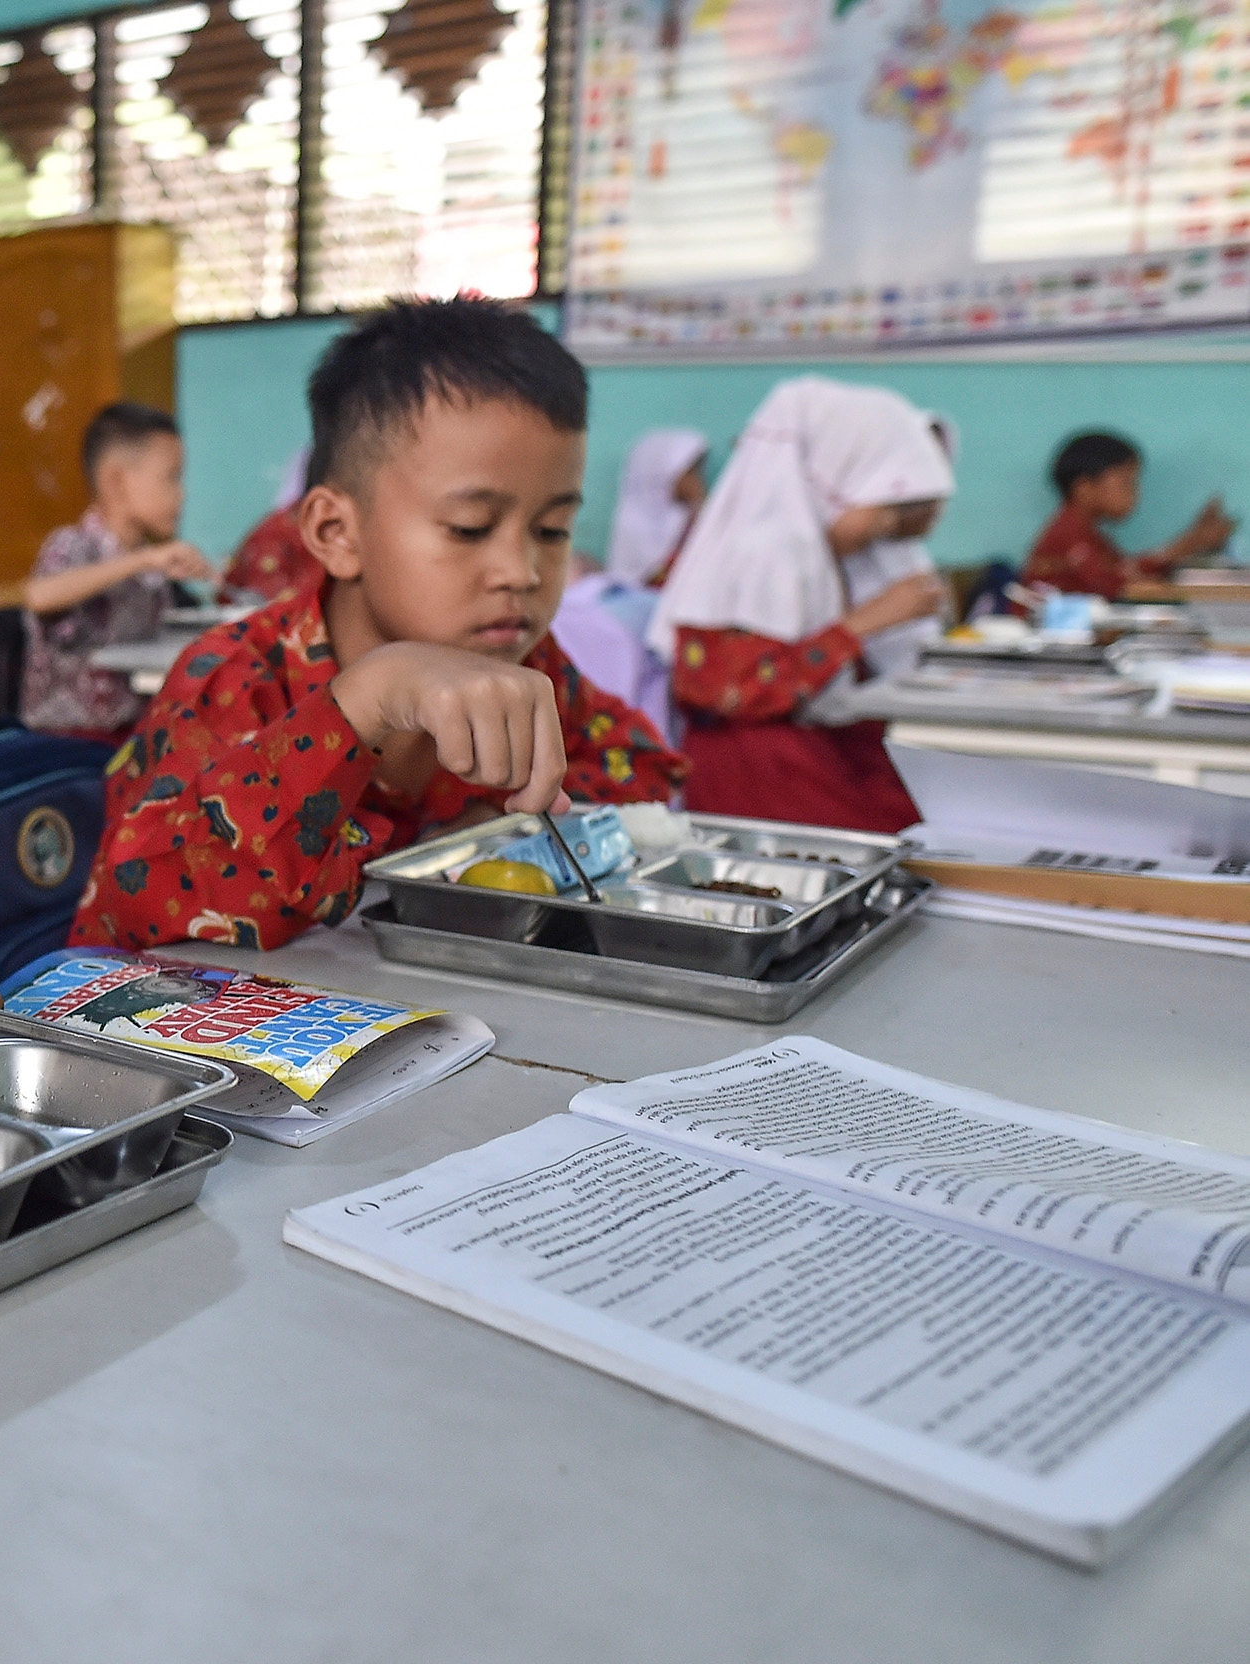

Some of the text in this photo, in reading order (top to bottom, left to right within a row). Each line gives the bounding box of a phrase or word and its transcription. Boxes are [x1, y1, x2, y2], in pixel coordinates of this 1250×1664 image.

[180, 987, 327, 1044] FIND
[227, 998, 362, 1054] CAN'T
[367, 1004, 409, 1022] IF
[267, 1019, 373, 1069] YOU
